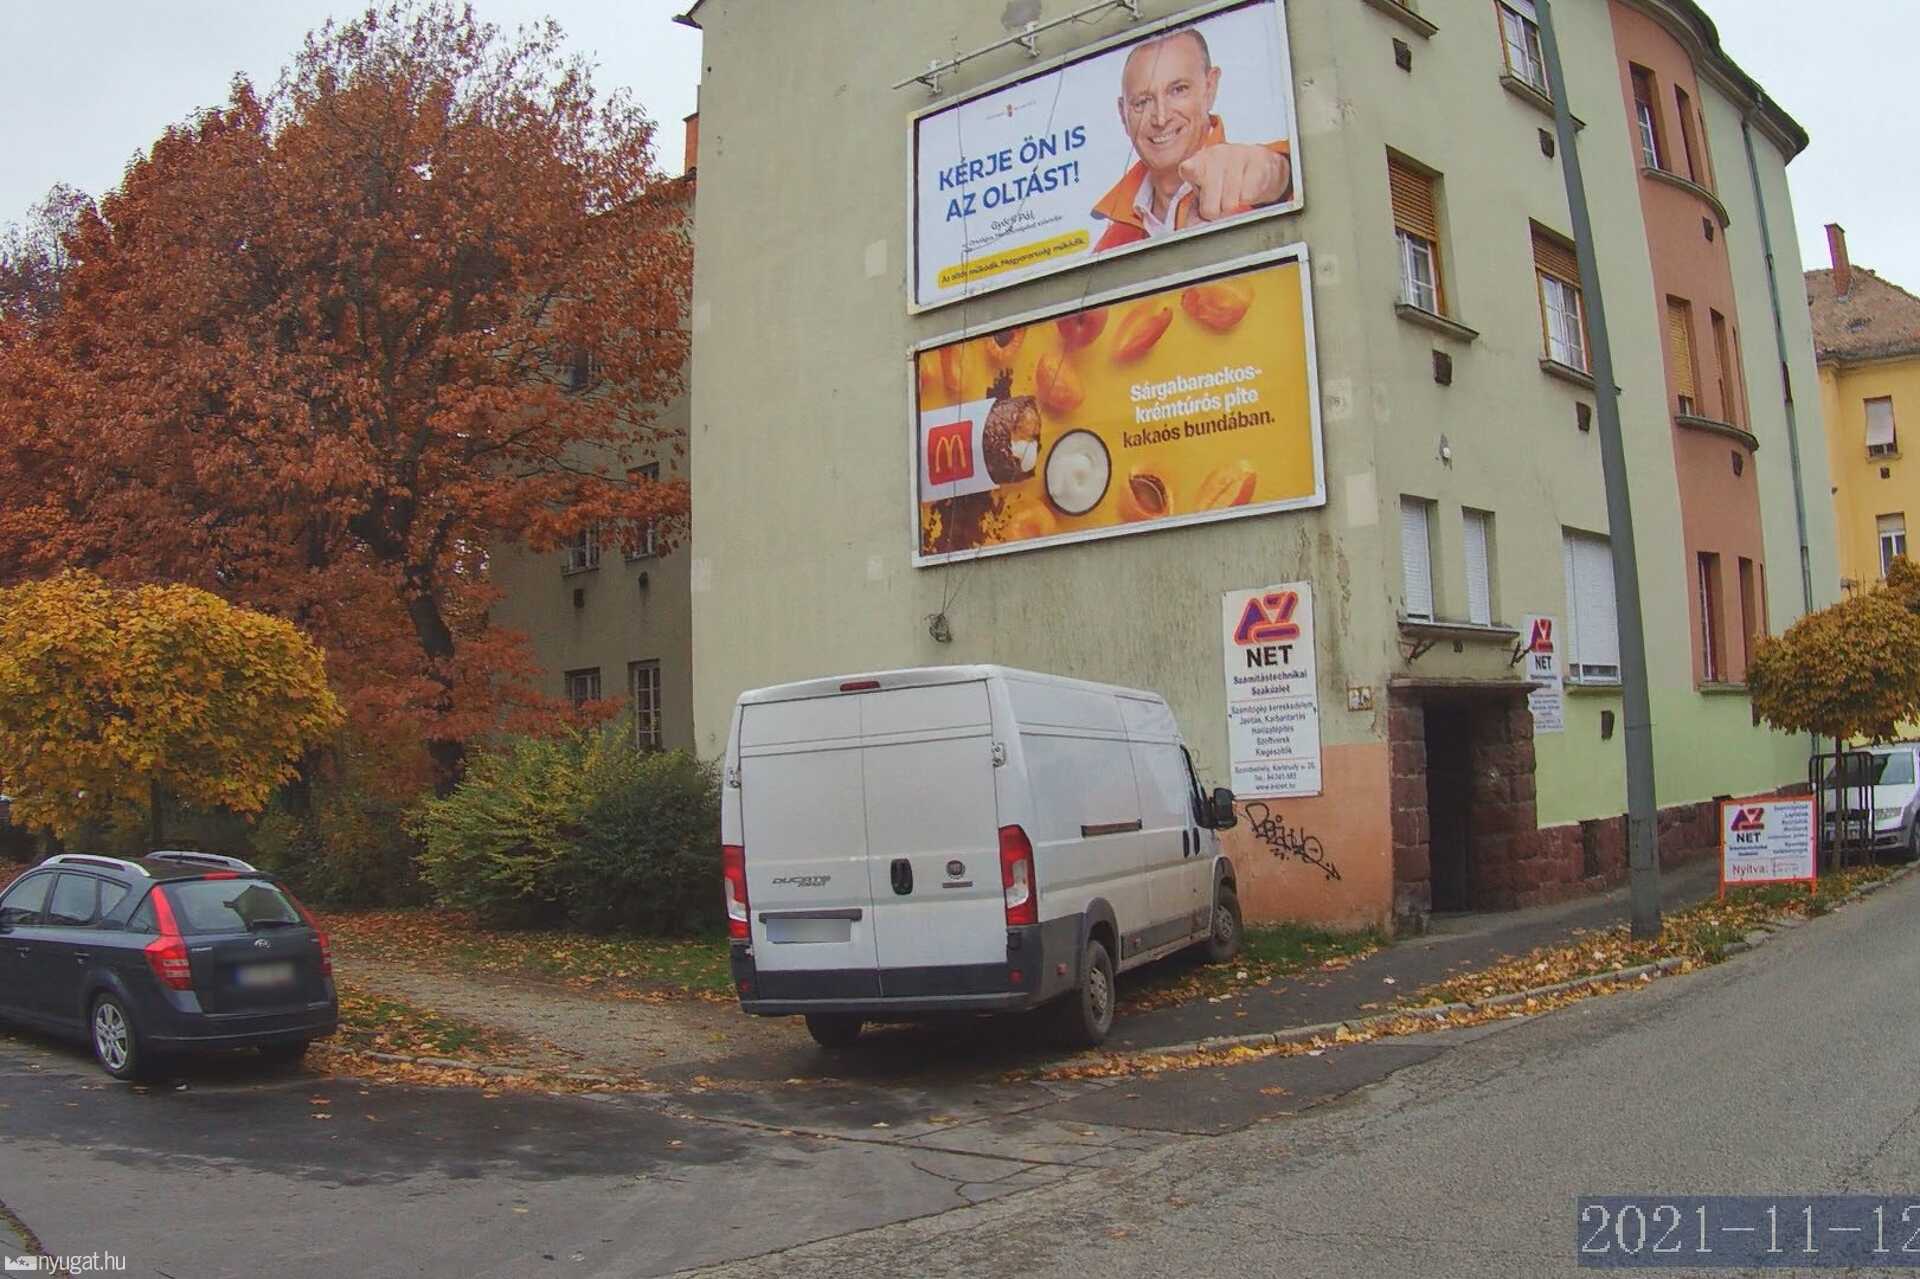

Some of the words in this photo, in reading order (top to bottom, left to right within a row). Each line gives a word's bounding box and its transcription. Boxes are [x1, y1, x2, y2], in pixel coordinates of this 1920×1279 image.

[1019, 135, 1056, 164] ÖN
[1065, 126, 1086, 151] IS
[946, 193, 976, 222] AZ
[982, 161, 1079, 208] OLTÁST!
[1225, 387, 1259, 412] pite
[1123, 424, 1180, 448] kakaós
[1184, 410, 1275, 438] bundában.
[1246, 645, 1293, 668] NET
[1534, 655, 1552, 671] NET
[1736, 831, 1761, 844] NET
